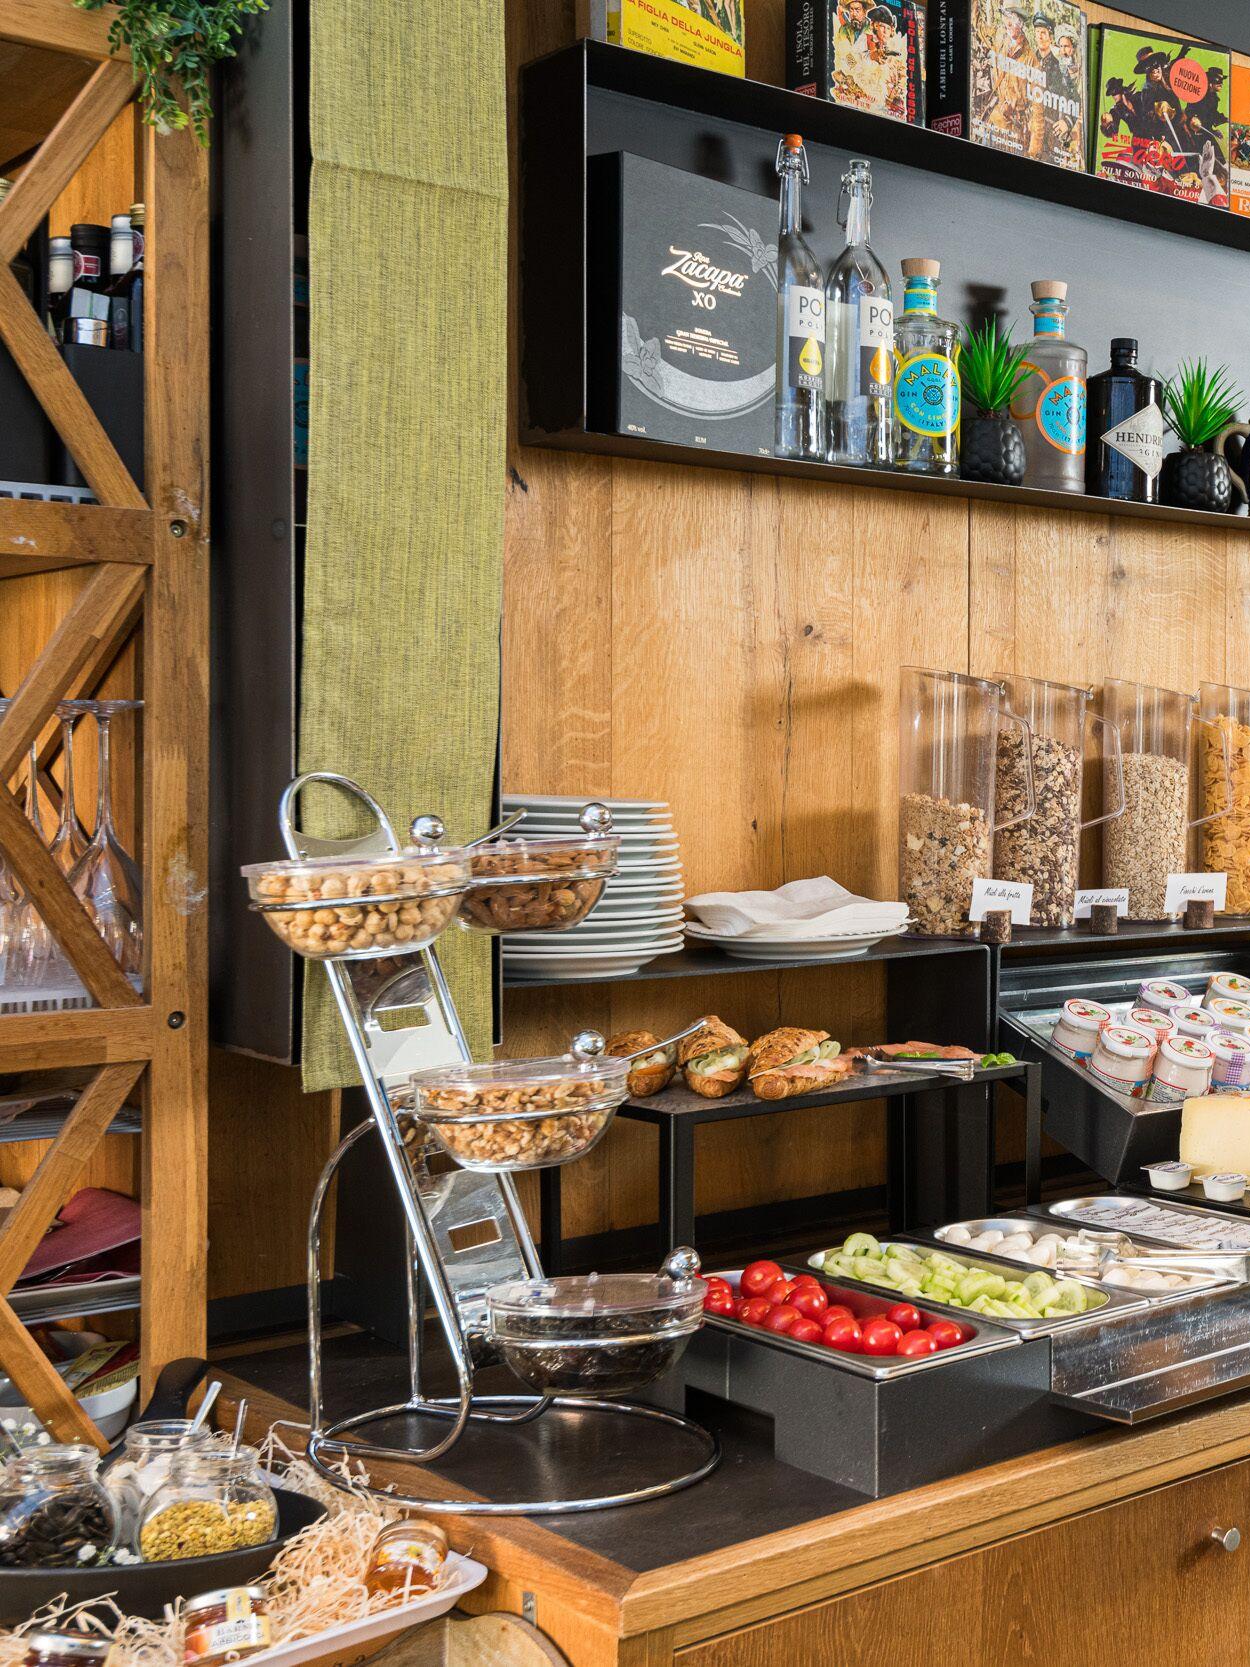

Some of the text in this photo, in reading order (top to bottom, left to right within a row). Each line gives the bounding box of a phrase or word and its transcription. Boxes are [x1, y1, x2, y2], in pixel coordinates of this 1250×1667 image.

[638, 0, 669, 22] FIGLIA
[671, 16, 703, 39] DELLA
[704, 34, 743, 58] JUNGLA
[1178, 67, 1200, 83] NUOVA
[1173, 78, 1202, 97] EDIZIONE
[1101, 166, 1121, 177] FILM
[1124, 168, 1158, 183] SONORO
[1173, 190, 1201, 199] COLOR
[692, 251, 710, 263] Ron
[661, 245, 745, 291] Zacapa
[691, 289, 717, 310] XO
[910, 402, 926, 417] CON
